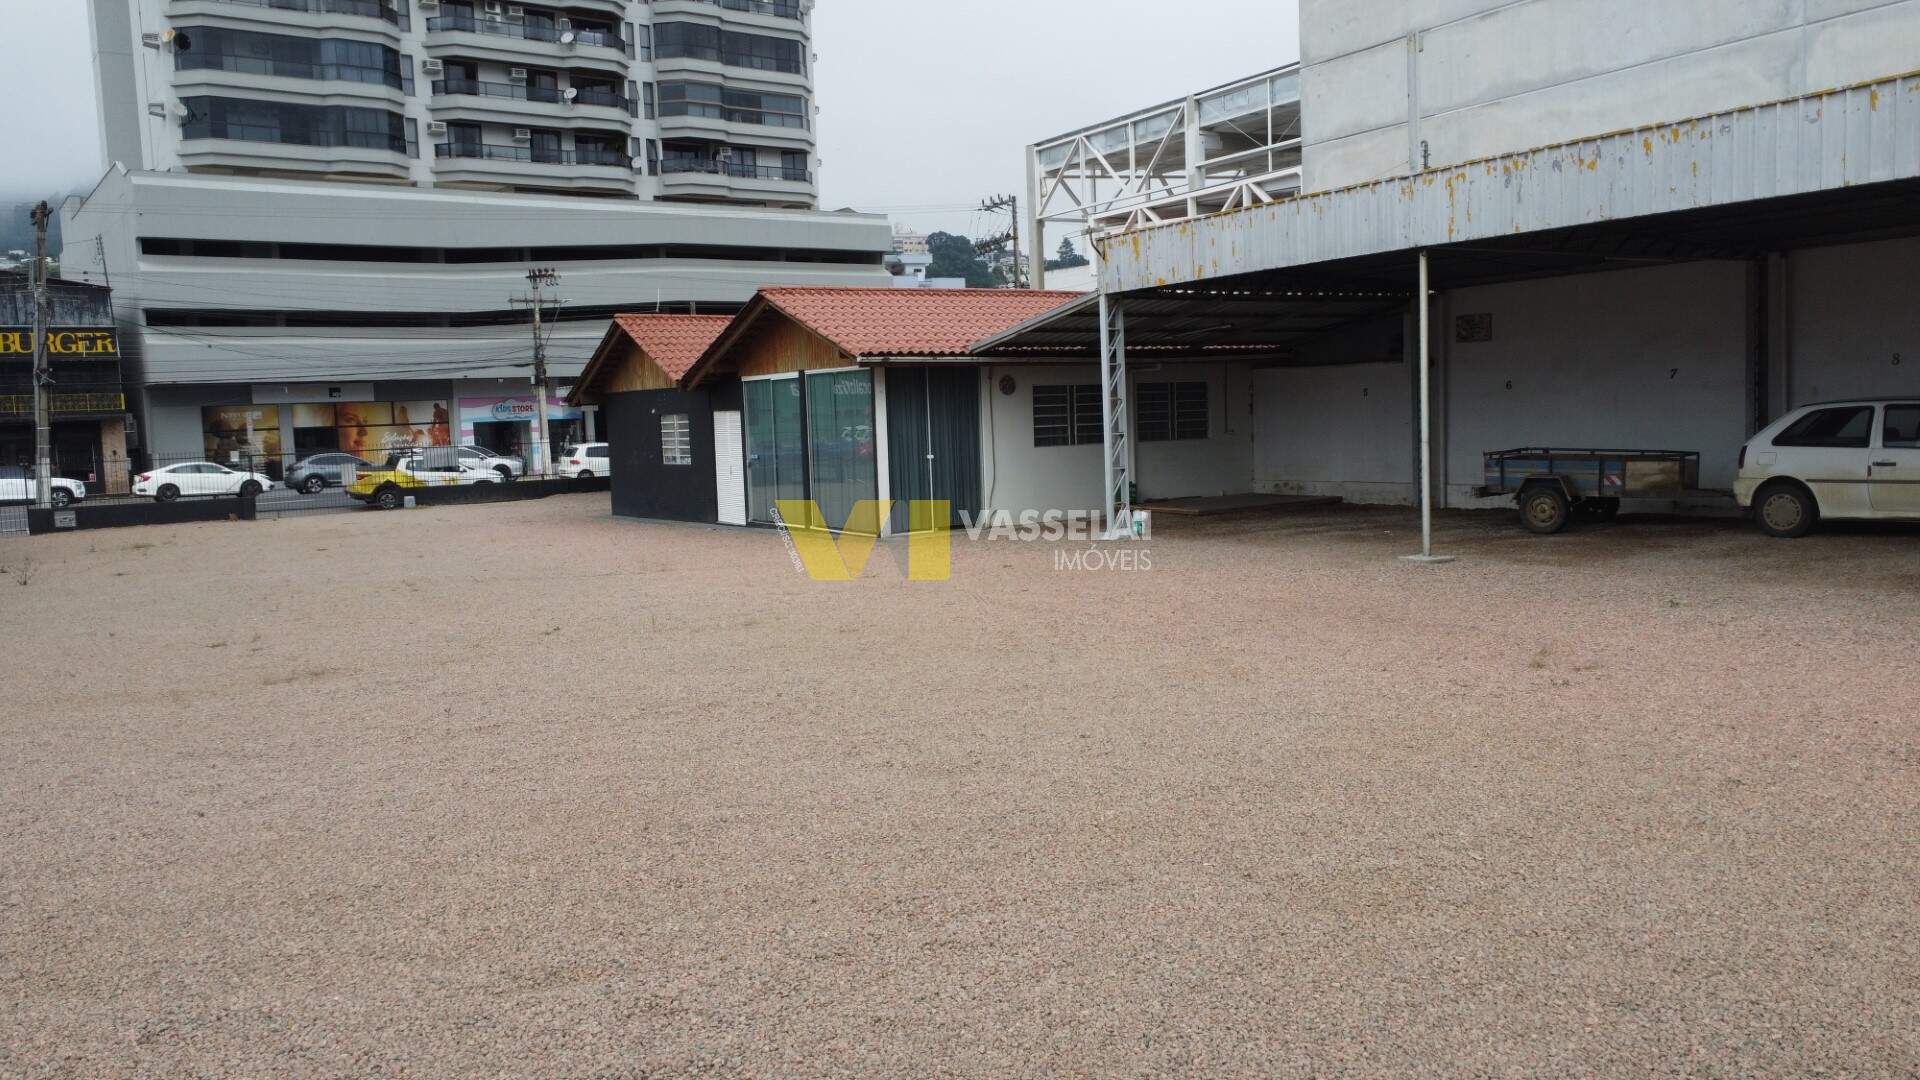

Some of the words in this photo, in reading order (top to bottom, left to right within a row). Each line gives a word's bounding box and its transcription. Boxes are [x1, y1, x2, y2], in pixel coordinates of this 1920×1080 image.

[1891, 353, 1900, 365] 8
[1670, 368, 1678, 379] 7
[1505, 380, 1512, 390] 6
